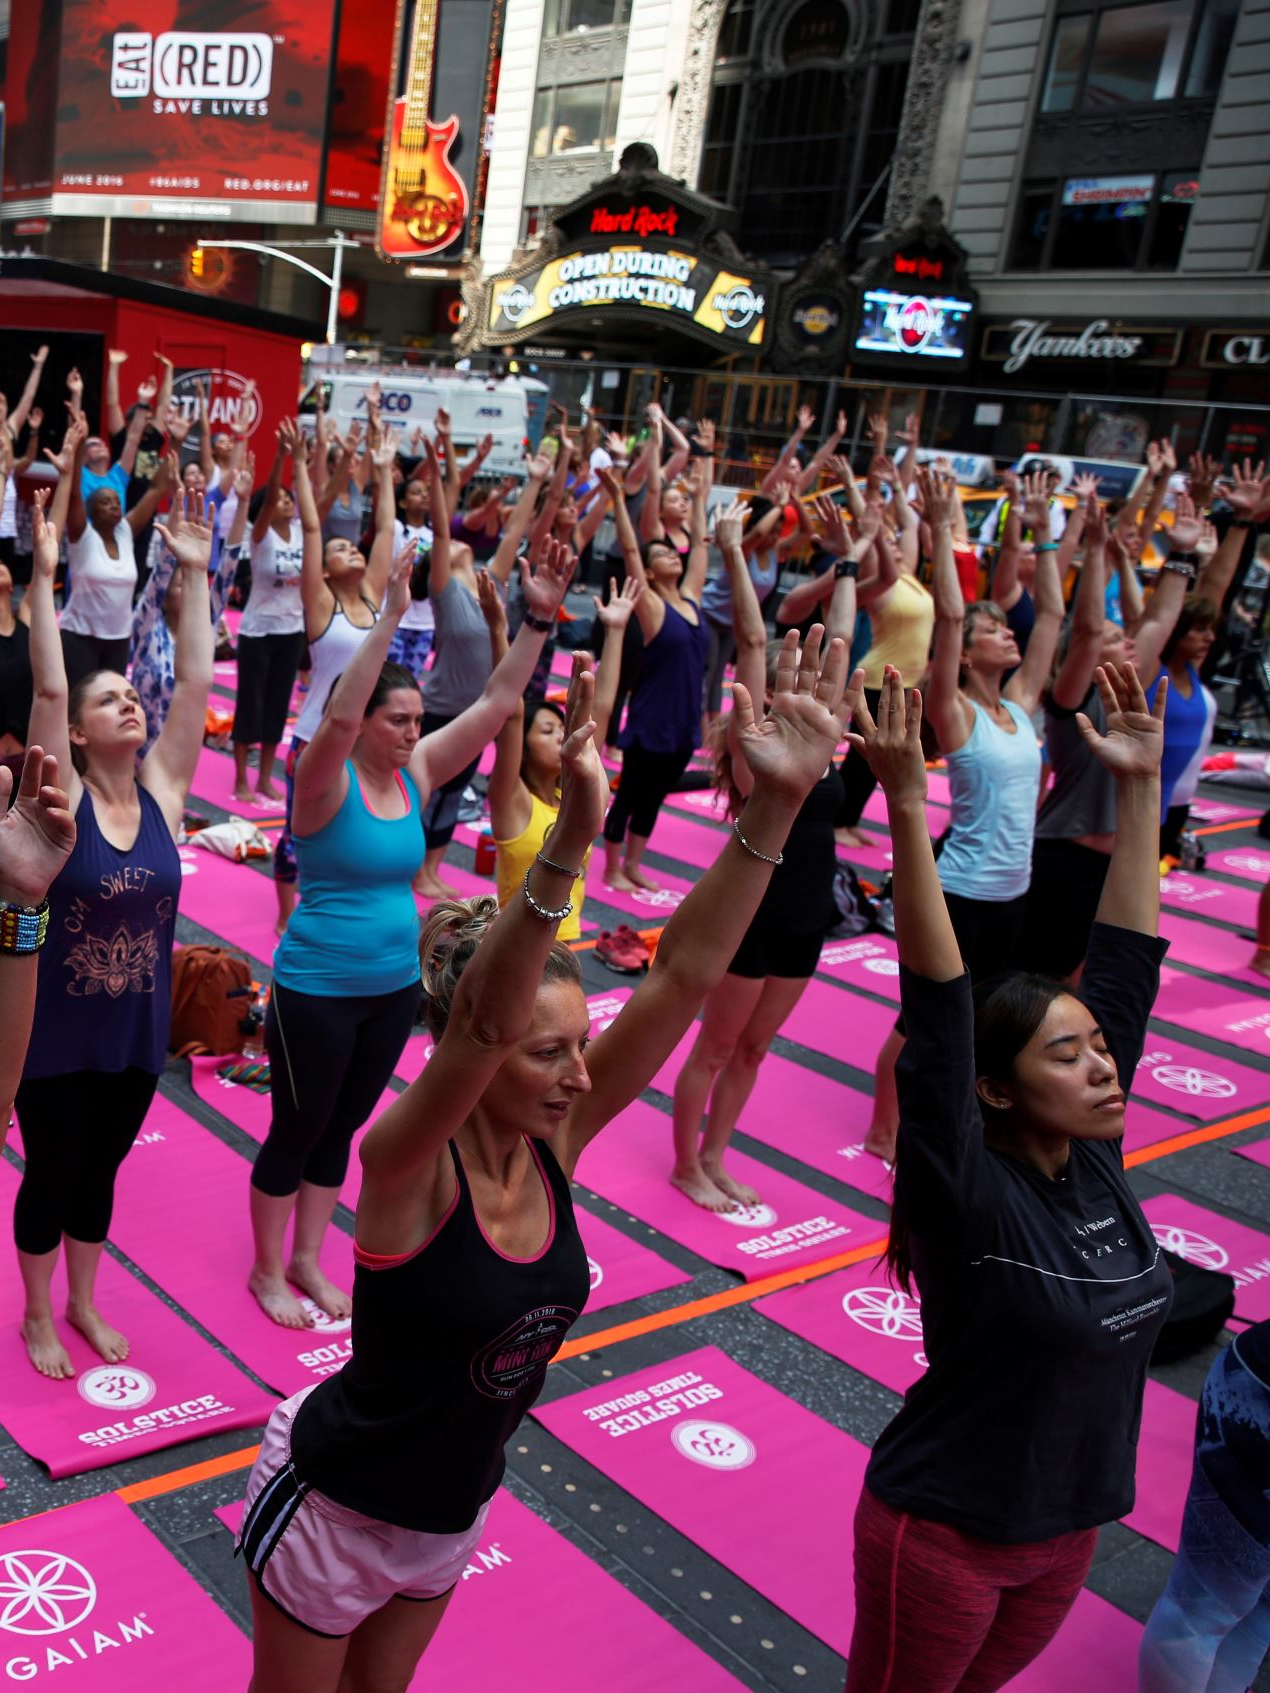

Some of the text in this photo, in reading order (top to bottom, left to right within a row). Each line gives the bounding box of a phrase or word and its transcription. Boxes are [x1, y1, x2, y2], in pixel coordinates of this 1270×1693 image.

[153, 99, 269, 116] SAVE LIVES
[60, 173, 93, 186] JUNE
[590, 205, 679, 237] Hard Rock
[559, 251, 691, 282] OPEN DURING
[550, 277, 696, 312] CONSTRUCTION
[1002, 319, 1143, 374] Yankees
[100, 867, 155, 900] SWEET
[736, 1216, 837, 1255] SOLSTICE
[582, 1371, 704, 1421] TIMES SQUARE
[598, 1383, 724, 1438] SOLSTICE
[78, 1394, 223, 1444] SOLSTICE
[5, 1615, 155, 1681] GAIAM
